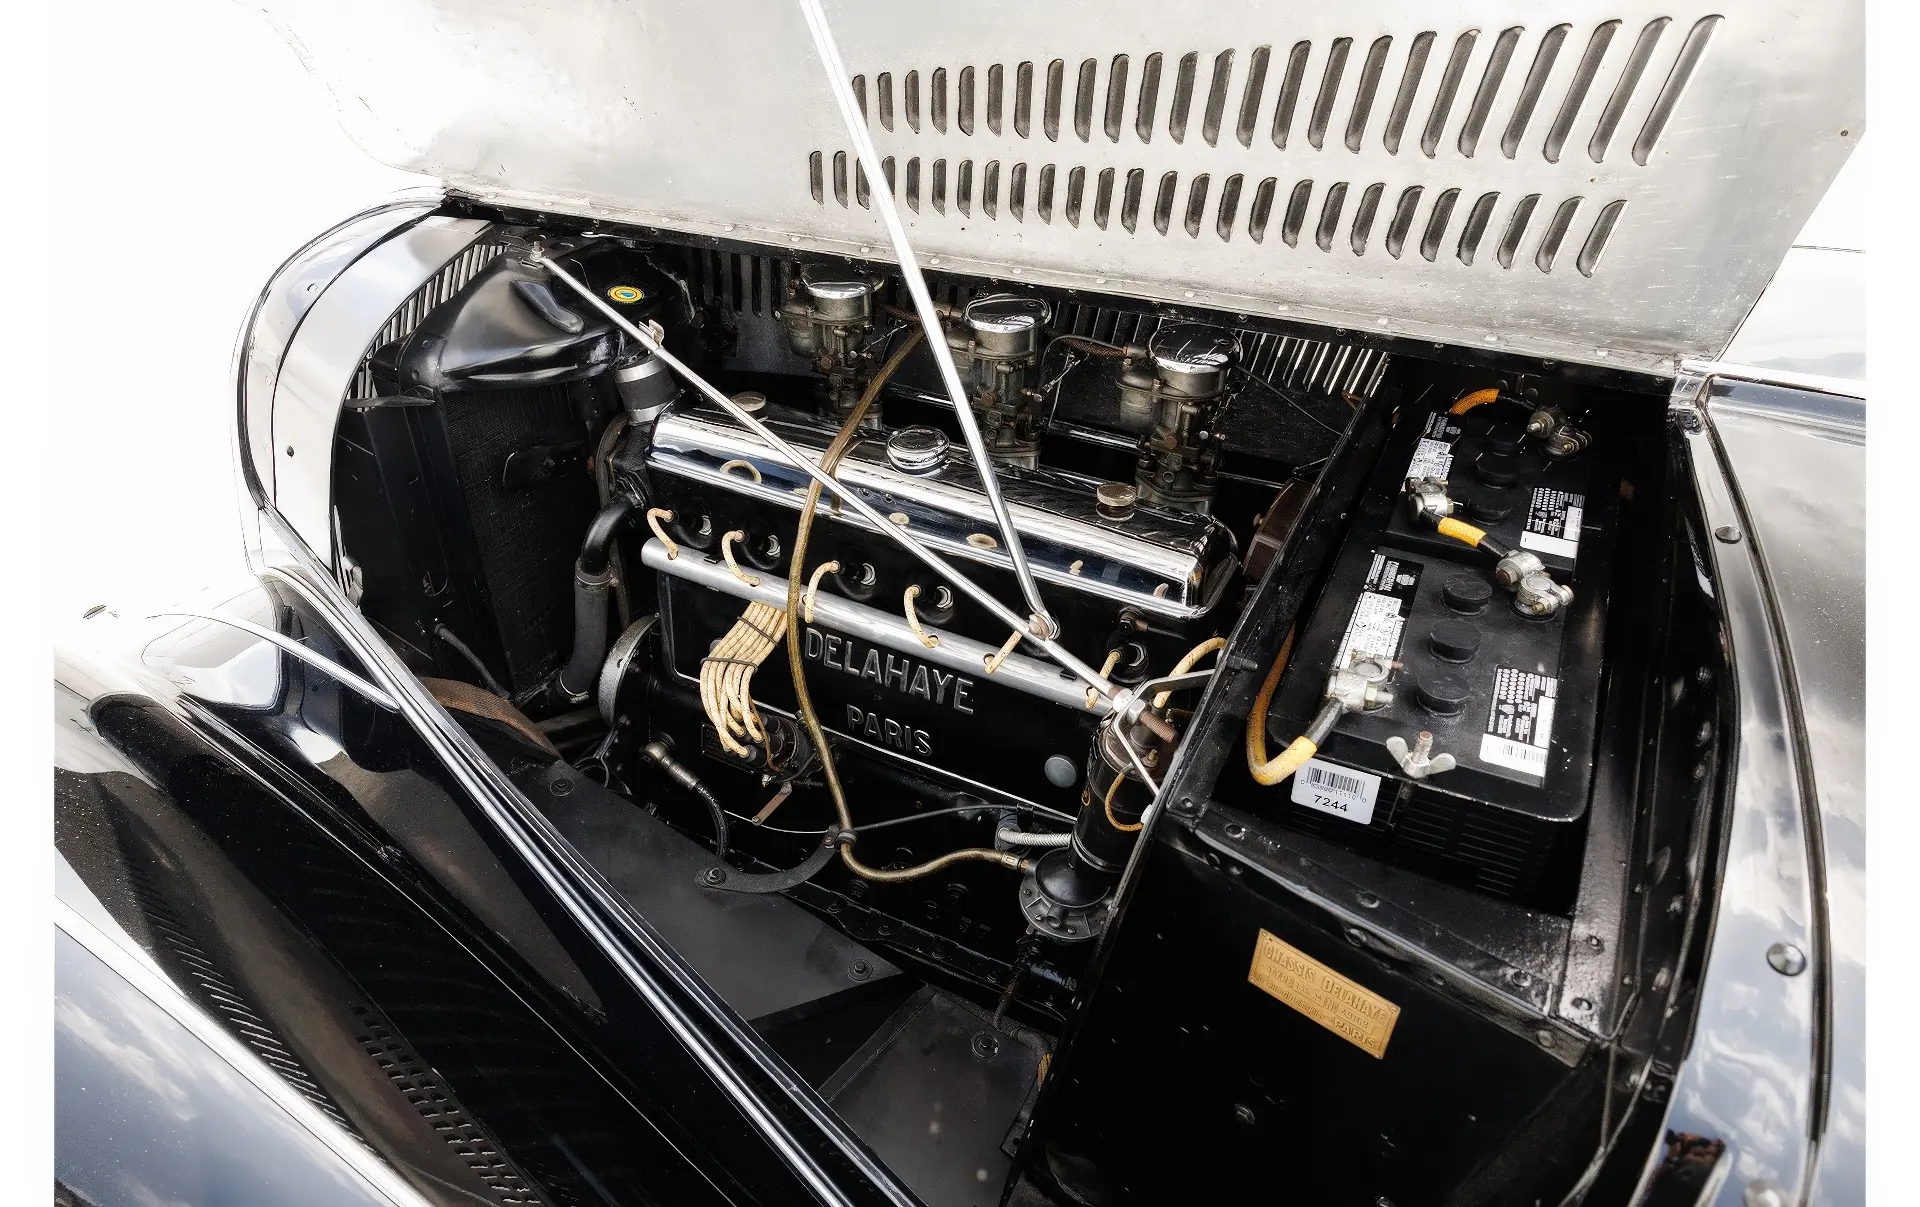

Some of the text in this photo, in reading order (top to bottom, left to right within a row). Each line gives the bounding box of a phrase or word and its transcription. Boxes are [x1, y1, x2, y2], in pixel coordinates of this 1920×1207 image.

[805, 627, 974, 716] DELAHAYE
[847, 704, 933, 757] PARIS
[1314, 794, 1348, 812] 7244
[1264, 943, 1316, 983] CHASSIS
[1321, 977, 1388, 1026] DELAHAYE
[1334, 1019, 1375, 1049] PARIS
